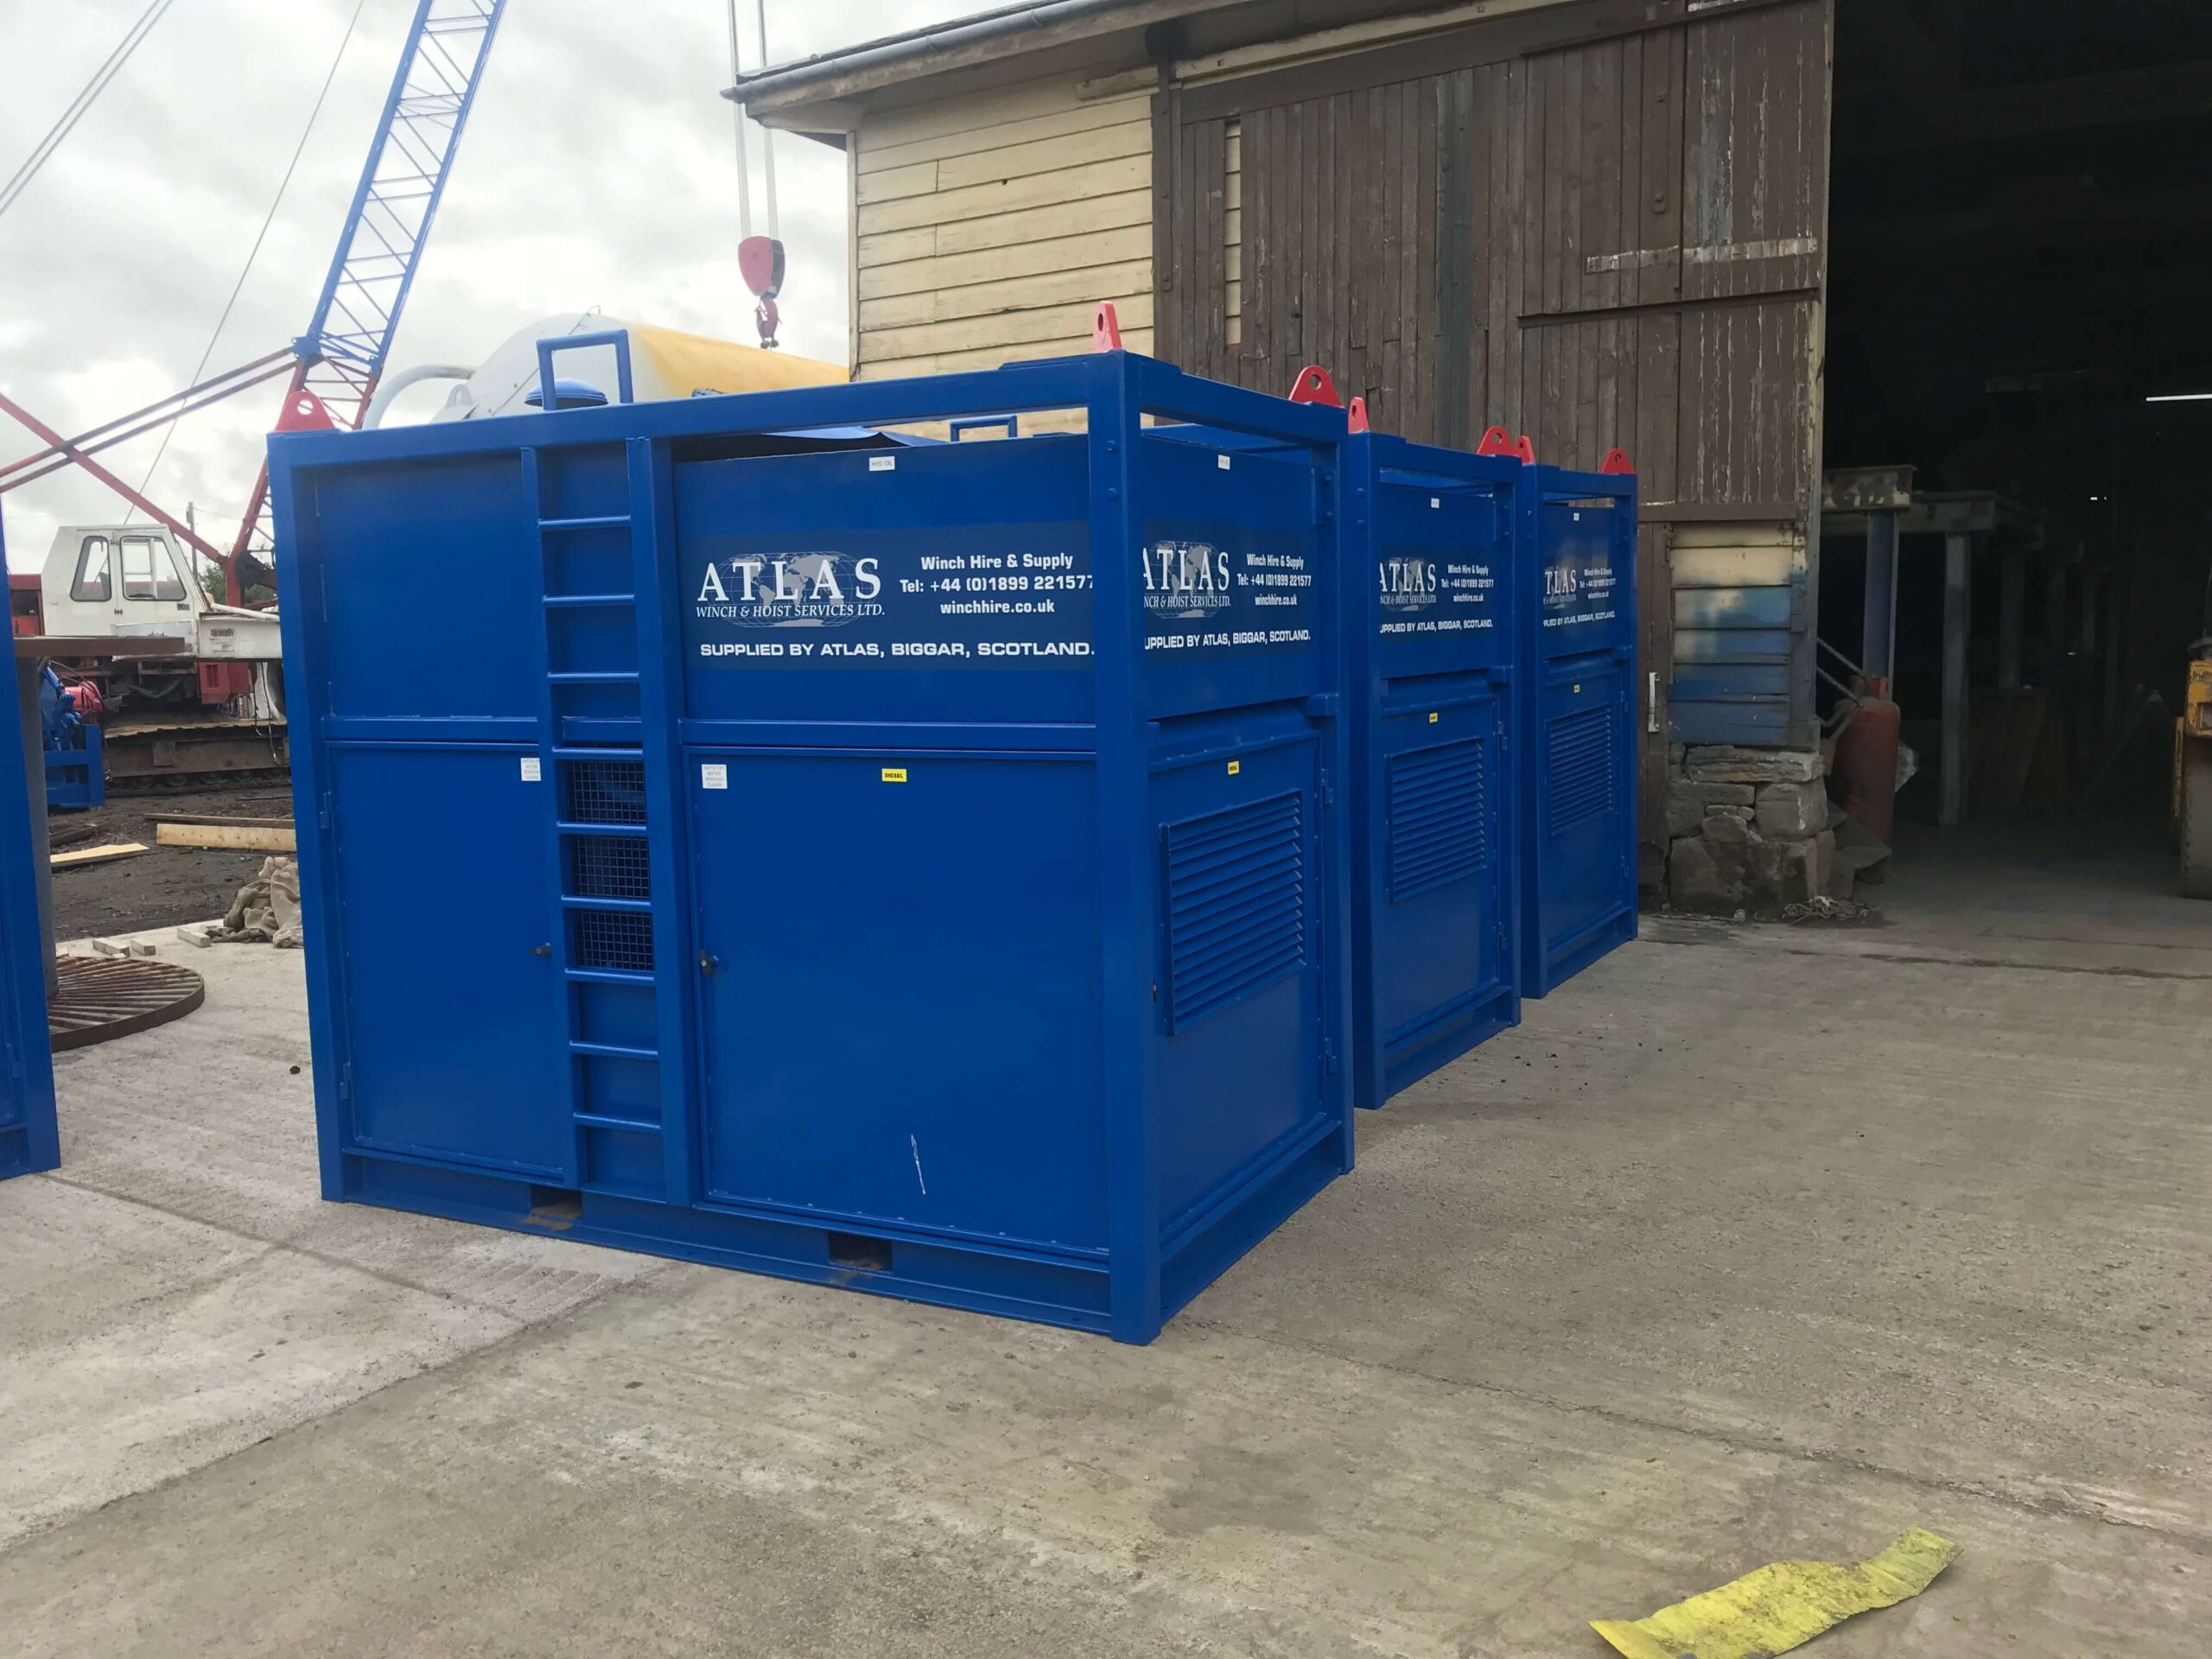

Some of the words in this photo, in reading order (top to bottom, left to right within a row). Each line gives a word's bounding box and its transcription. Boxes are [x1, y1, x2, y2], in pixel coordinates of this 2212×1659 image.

[921, 556, 965, 570] Winch
[970, 555, 1001, 569] Hire
[1007, 554, 1018, 568] &
[1023, 552, 1073, 570] Supply
[1247, 553, 1266, 566] Winch
[1267, 554, 1279, 567] Hire
[1281, 555, 1285, 567] &
[1286, 556, 1304, 570] Supply
[1448, 564, 1461, 574] Winch
[1476, 565, 1489, 576] Supply
[697, 558, 881, 601] ATLAS
[899, 579, 924, 593] Tel:
[930, 578, 961, 593] +44
[966, 576, 1028, 591] (0)1899
[1033, 575, 1093, 590] 221577
[1237, 574, 1249, 586] Tel:
[1250, 574, 1264, 586] +44
[1266, 574, 1288, 586] (0)1899
[1289, 575, 1312, 587] 221577
[1545, 569, 1576, 594] TLAS
[940, 599, 1055, 614] winchhire.co.uk
[1143, 595, 1159, 608] NCH
[1160, 596, 1166, 607] &
[1167, 596, 1189, 607] HOIST
[1190, 596, 1218, 607] SERVICES
[1218, 596, 1231, 607] LTD.
[1255, 594, 1297, 606] winchhire.co.uk
[696, 606, 737, 618] WINCH
[741, 607, 750, 617] &
[753, 605, 791, 617] HOIST
[794, 604, 854, 616] SERVICES
[857, 604, 886, 616] LTD.
[1407, 623, 1415, 632] BY
[1417, 621, 1437, 632] ATLAS,
[1438, 620, 1462, 631] BIGGAR,
[1463, 619, 1493, 629] SCOTLAND.
[1144, 636, 1184, 650] UPPLIED
[1186, 635, 1200, 647] BY
[1203, 633, 1230, 647] ATLAS,
[1233, 632, 1268, 645] BIGGAR,
[1269, 629, 1311, 642] SCOTLAND.
[700, 644, 784, 657] SUPPLIED
[790, 644, 814, 656] BY
[821, 643, 885, 658] ATLAS,
[892, 643, 970, 658] BIGGAR,
[977, 642, 1095, 656] SCOTLAND.
